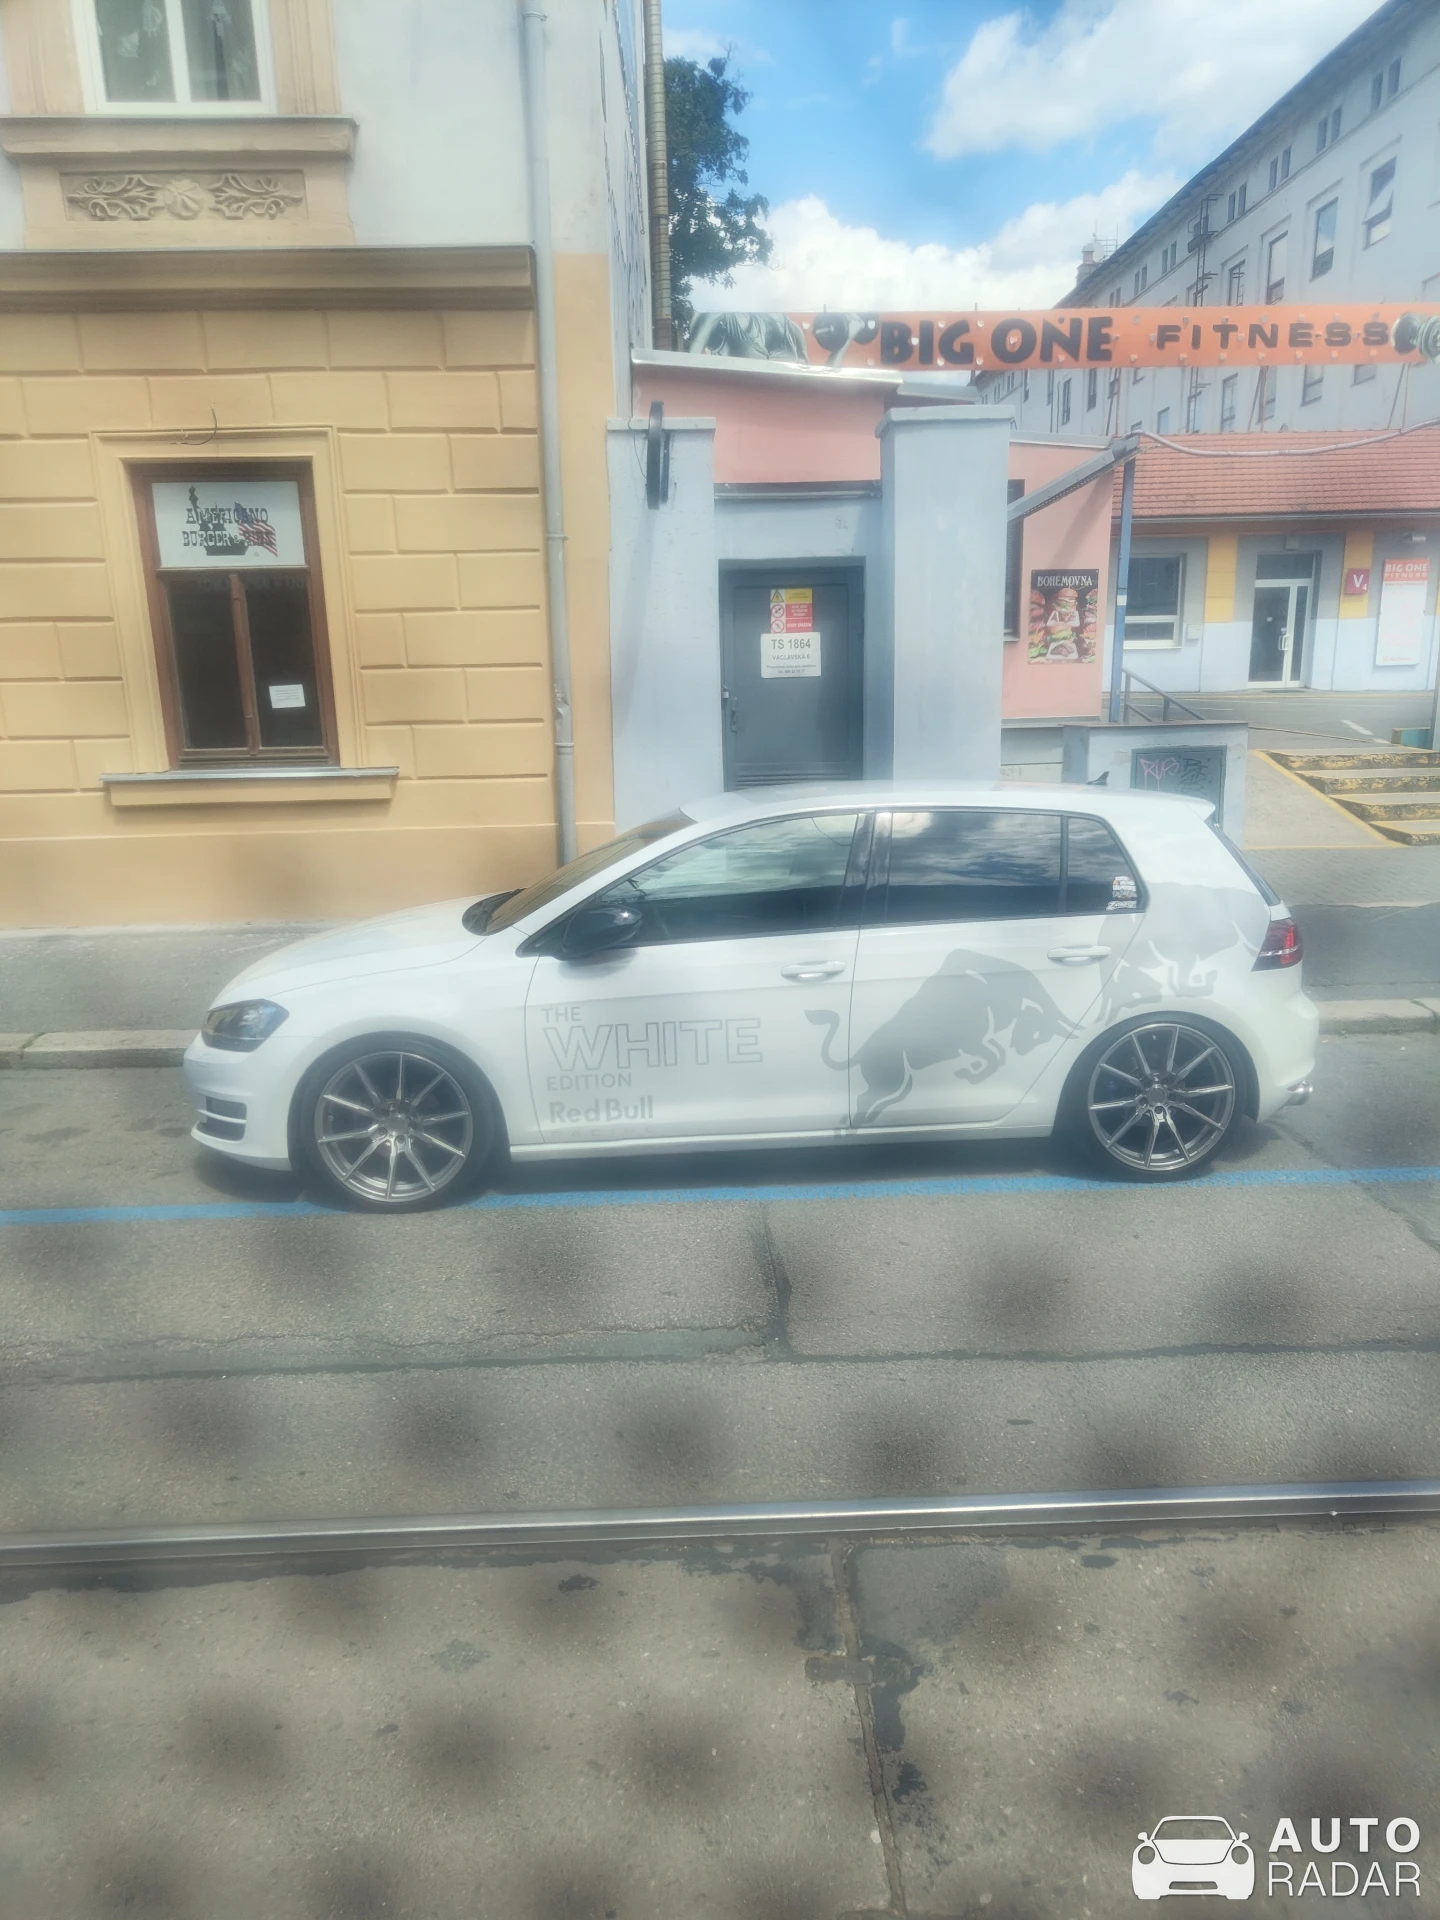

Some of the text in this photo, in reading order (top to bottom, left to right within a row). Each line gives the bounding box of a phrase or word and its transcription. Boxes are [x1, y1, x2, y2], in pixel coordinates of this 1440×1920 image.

[880, 316, 1389, 365] BIG ONE FITNESS
[182, 531, 231, 547] BURGER
[1385, 563, 1428, 573] BIG ONE
[771, 639, 811, 649] TS 1864
[541, 1006, 582, 1023] THE
[543, 1018, 763, 1072] WHITE
[546, 1072, 632, 1091] EDITION
[550, 1096, 654, 1124] Red Bull
